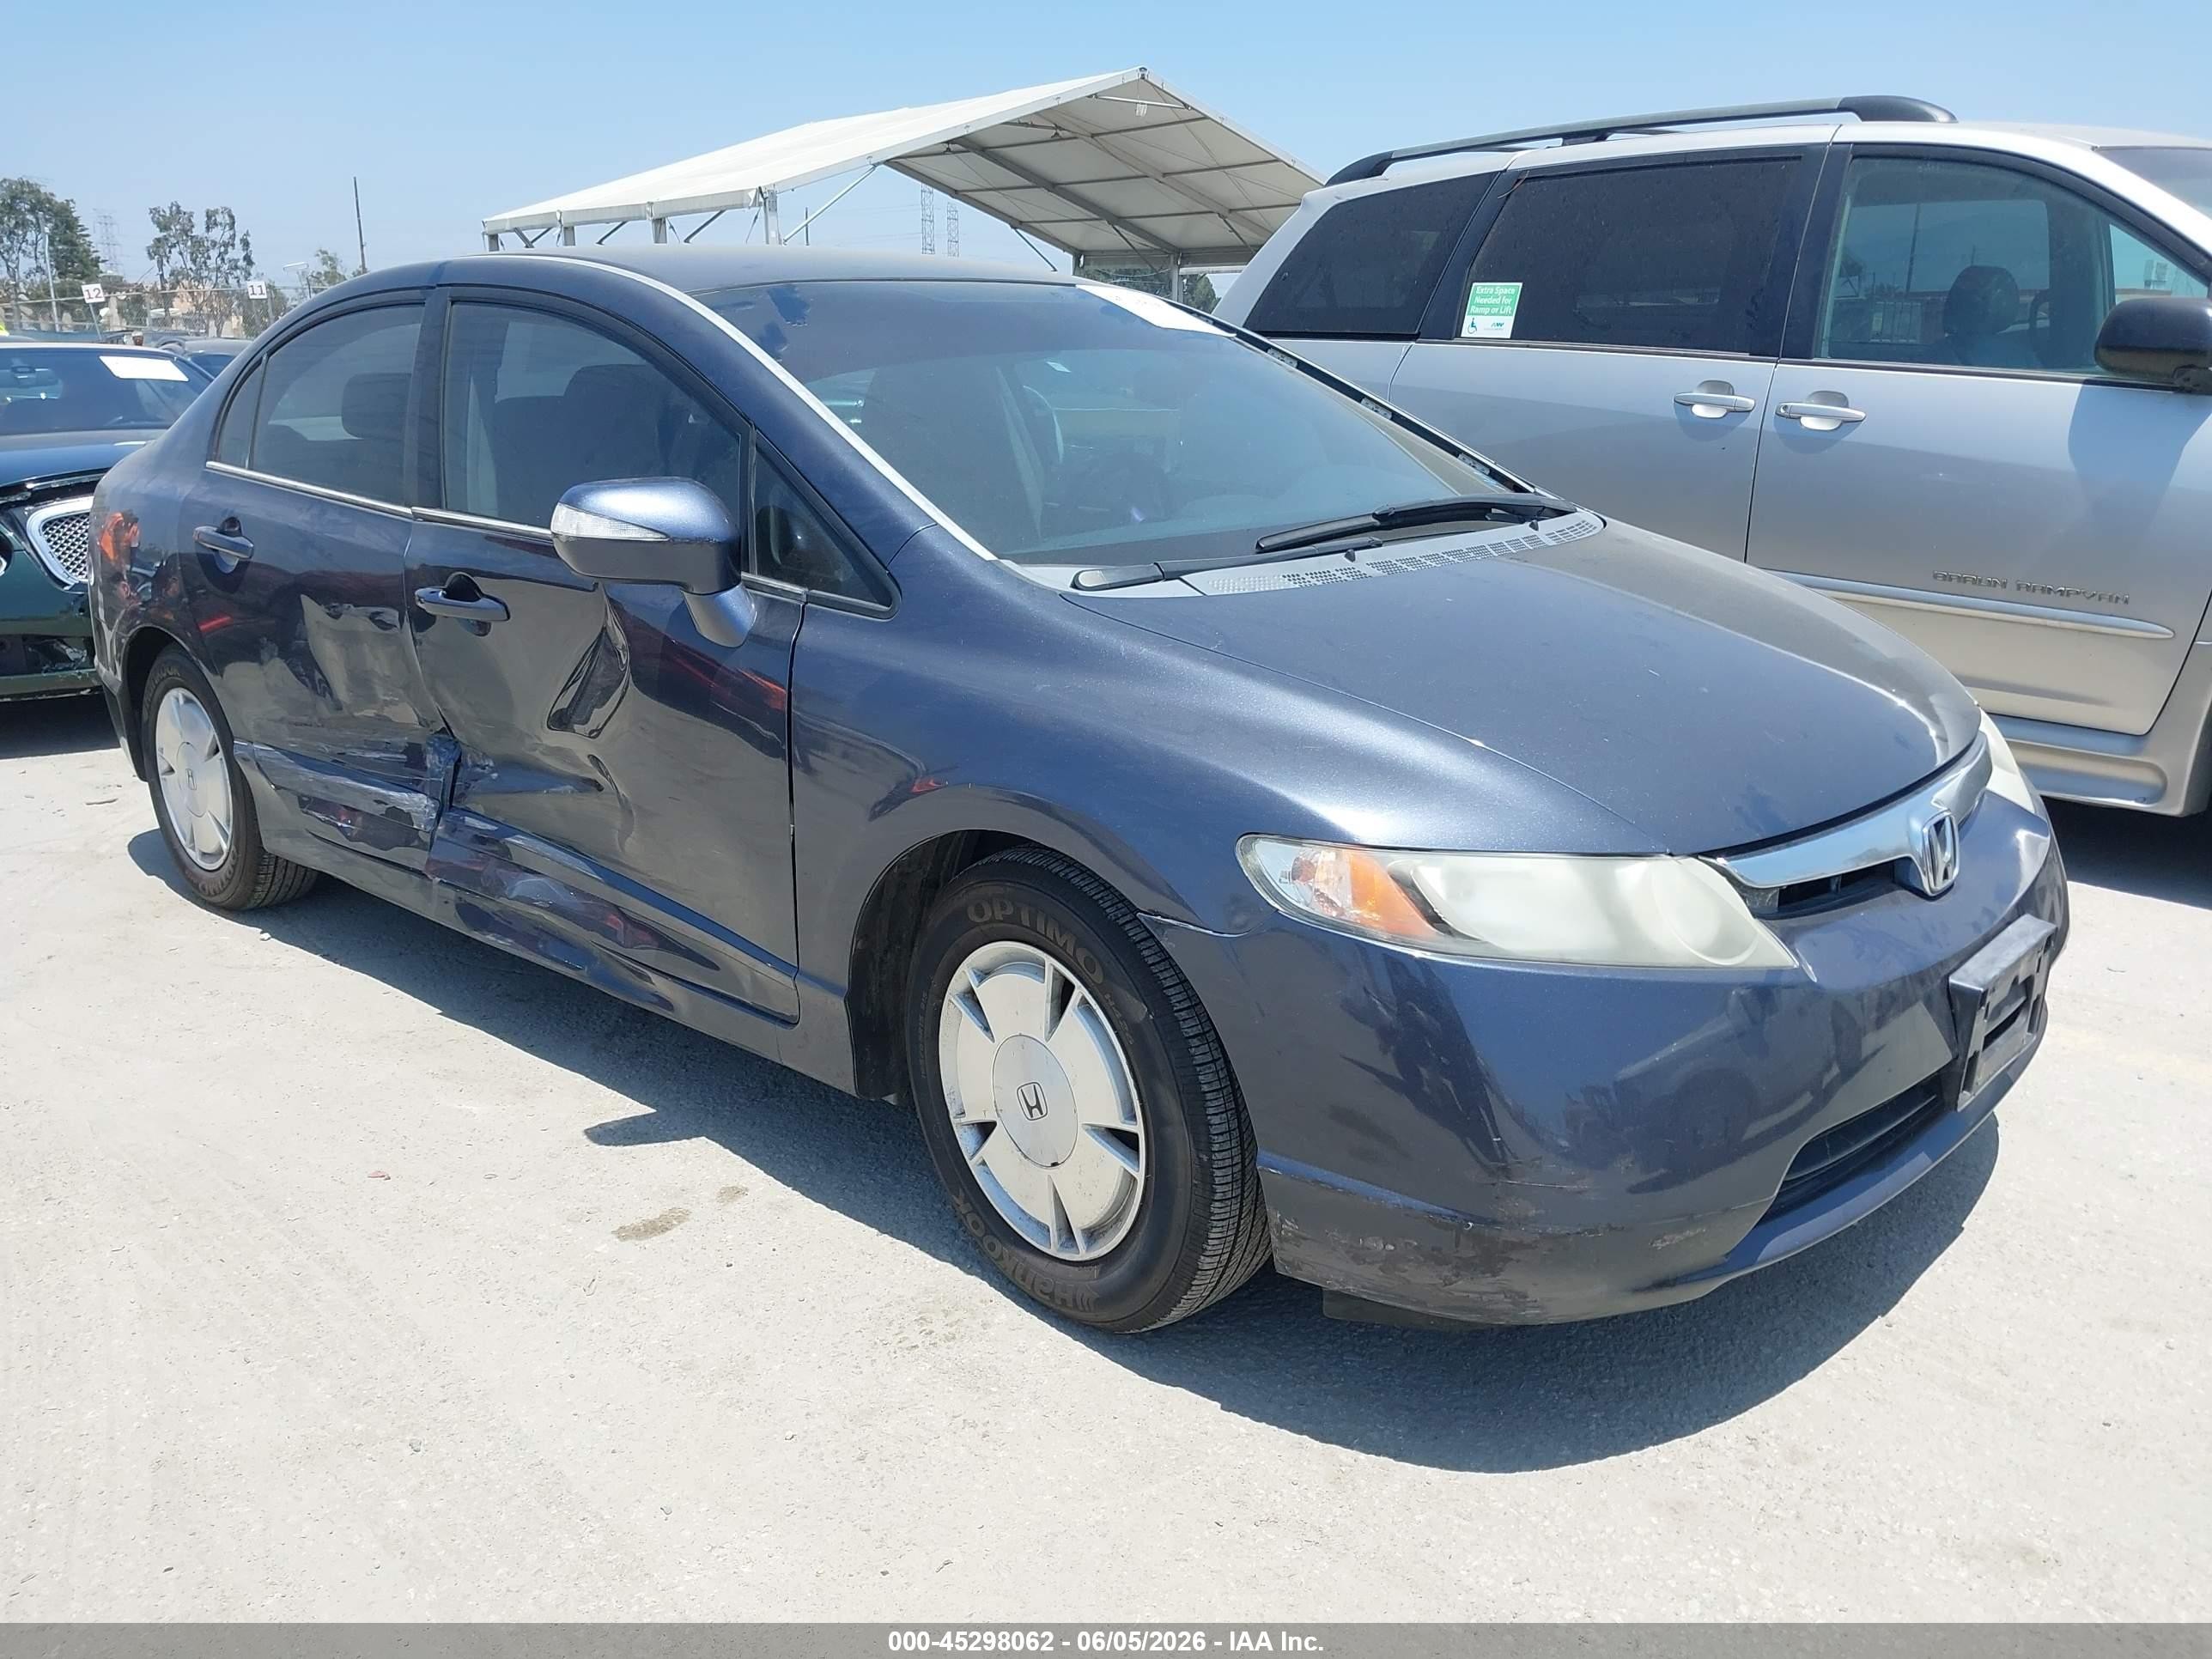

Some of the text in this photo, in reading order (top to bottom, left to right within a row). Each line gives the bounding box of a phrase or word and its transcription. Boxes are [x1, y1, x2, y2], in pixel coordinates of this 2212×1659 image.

[84, 288, 102, 300] 12
[249, 284, 266, 296] 11
[1475, 285, 1516, 295] Extra Space
[1474, 295, 1513, 304] Needed for
[1470, 305, 1490, 314] Ramp
[1499, 305, 1512, 314] Lift
[1932, 570, 2130, 605] BRAUN RAMPVAN
[966, 898, 1104, 985] OPTIMO
